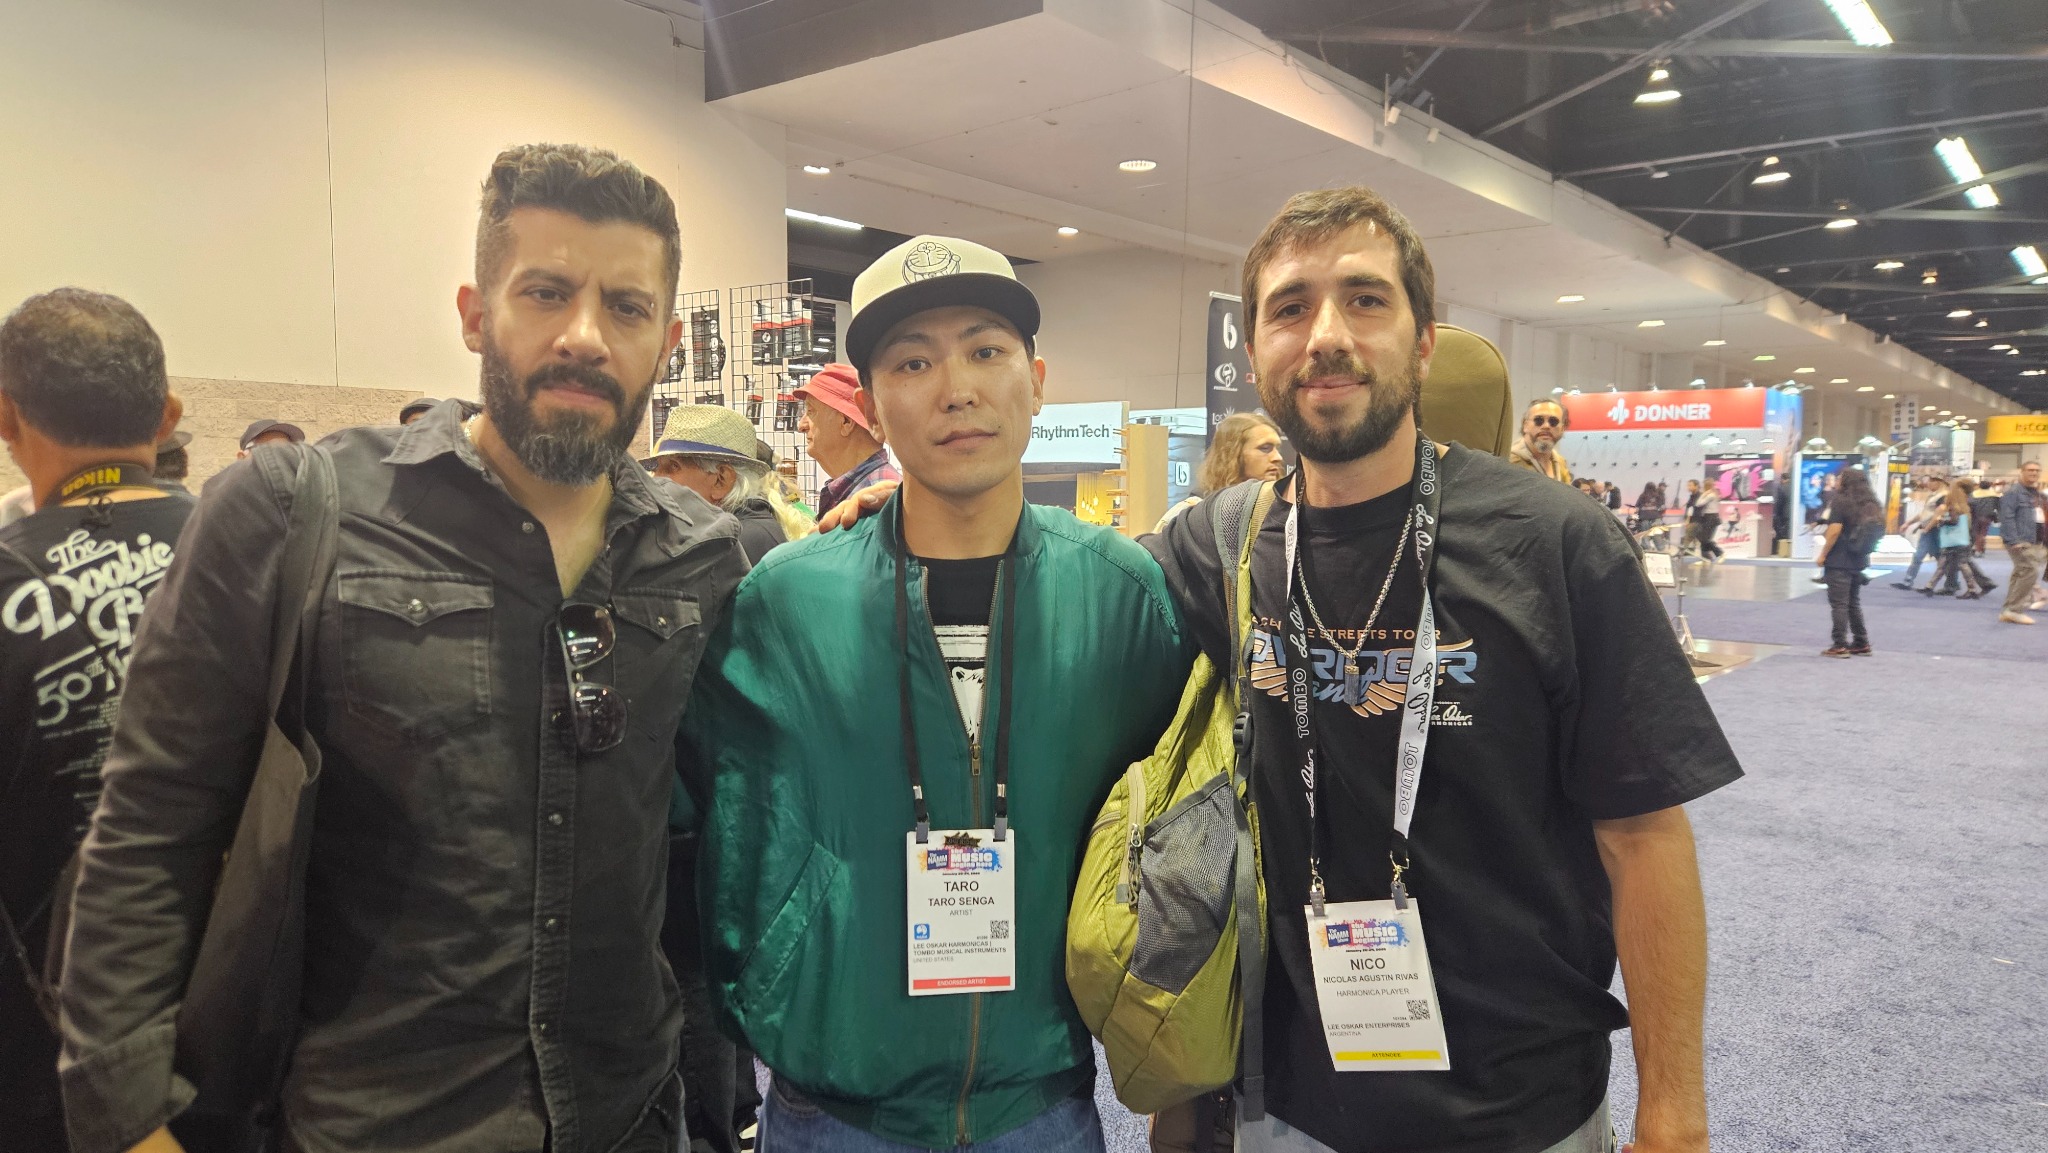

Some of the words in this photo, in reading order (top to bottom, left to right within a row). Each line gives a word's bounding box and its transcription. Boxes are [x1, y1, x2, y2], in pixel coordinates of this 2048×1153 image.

[1634, 403, 1712, 421] DONNER
[1031, 424, 1110, 441] RhythmTech
[1420, 439, 1435, 495] TOMBO
[61, 467, 120, 496] Nikon
[46, 529, 112, 573] The
[2, 533, 175, 640] Doobie
[1292, 668, 1310, 739] TOMBO
[928, 855, 948, 865] NAMM
[951, 853, 993, 863] MUSIC
[944, 881, 980, 892] TARO
[928, 898, 956, 907] TARO
[959, 896, 995, 906] SENGA
[1328, 930, 1350, 941] NAMM
[1352, 926, 1398, 939] MUSIC
[948, 940, 989, 948] HARMONICAS
[1350, 957, 1386, 971] NICO
[937, 979, 967, 987] ENDORSED
[1323, 975, 1358, 984] NICOLAS
[1359, 974, 1394, 982] AGUSTIN
[1395, 972, 1419, 981] RIVAS
[1336, 988, 1381, 997] HARMONICA
[1381, 987, 1410, 996] PLAYER
[1365, 1021, 1410, 1029] ENTERPRISES
